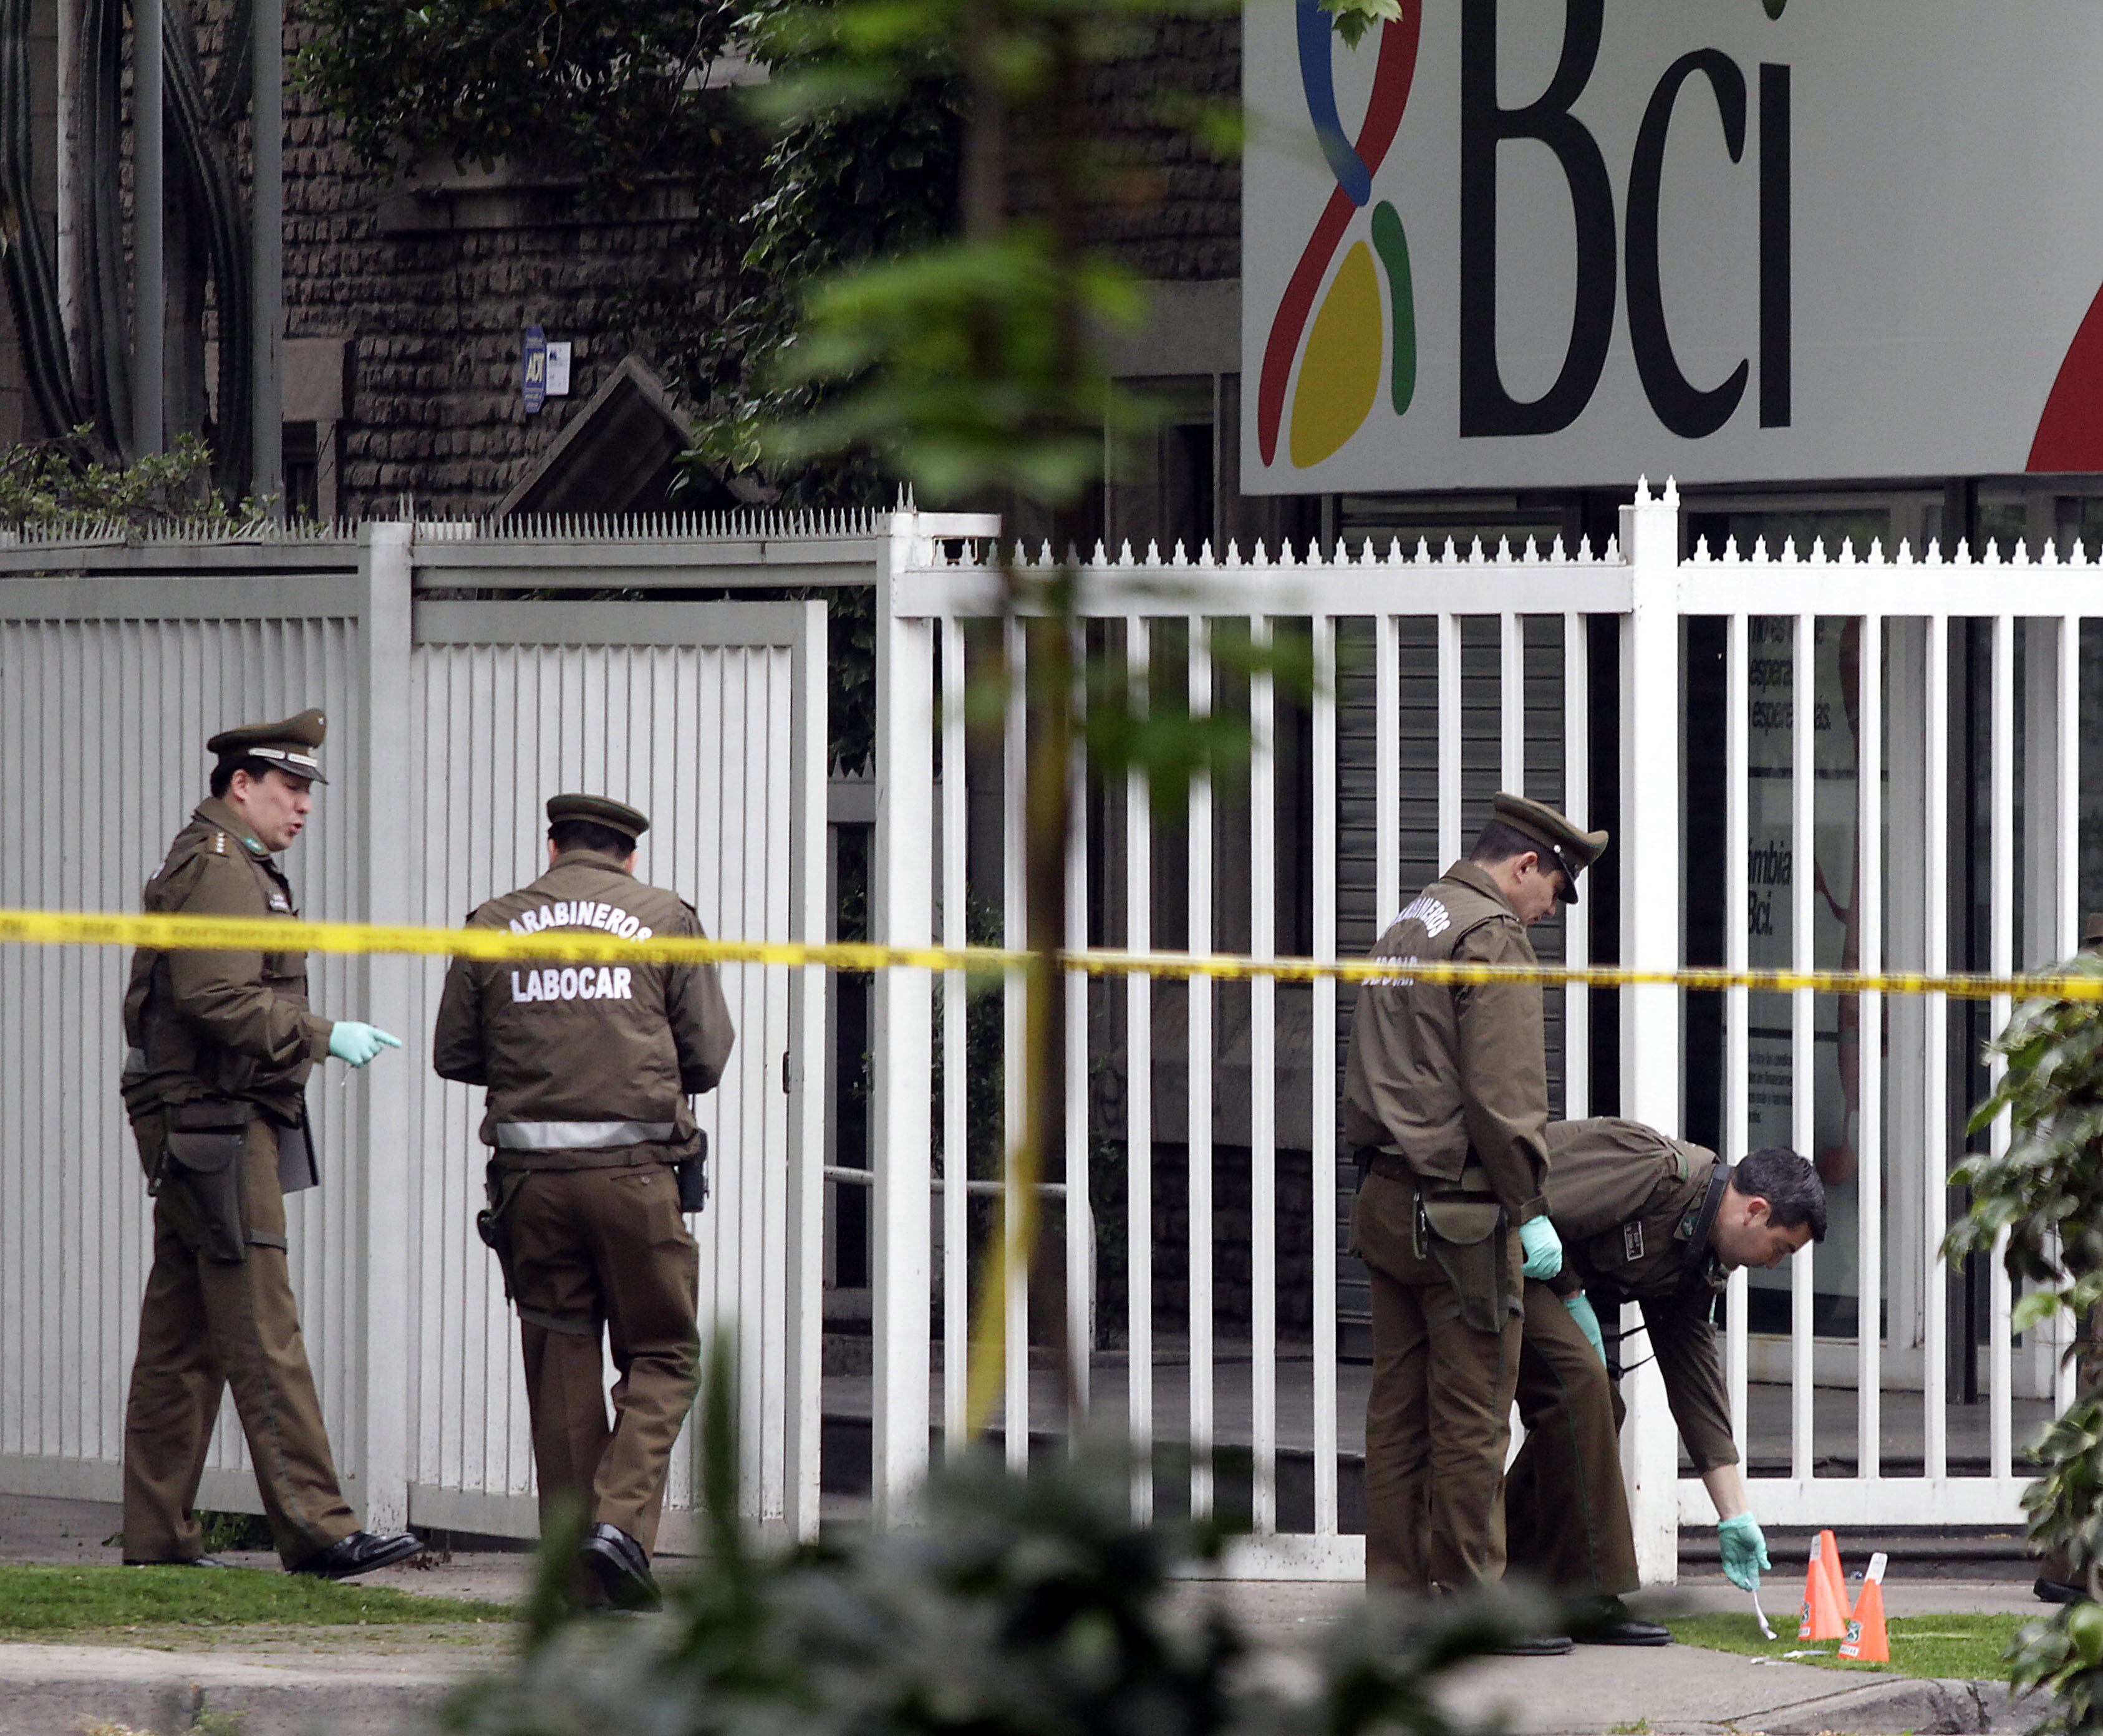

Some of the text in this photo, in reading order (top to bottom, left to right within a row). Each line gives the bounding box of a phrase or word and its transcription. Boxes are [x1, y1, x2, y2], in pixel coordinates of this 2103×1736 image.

[1460, 0, 1791, 439] Bci
[501, 900, 653, 943] ARABINEROS
[511, 967, 632, 1003] LABOCAR
